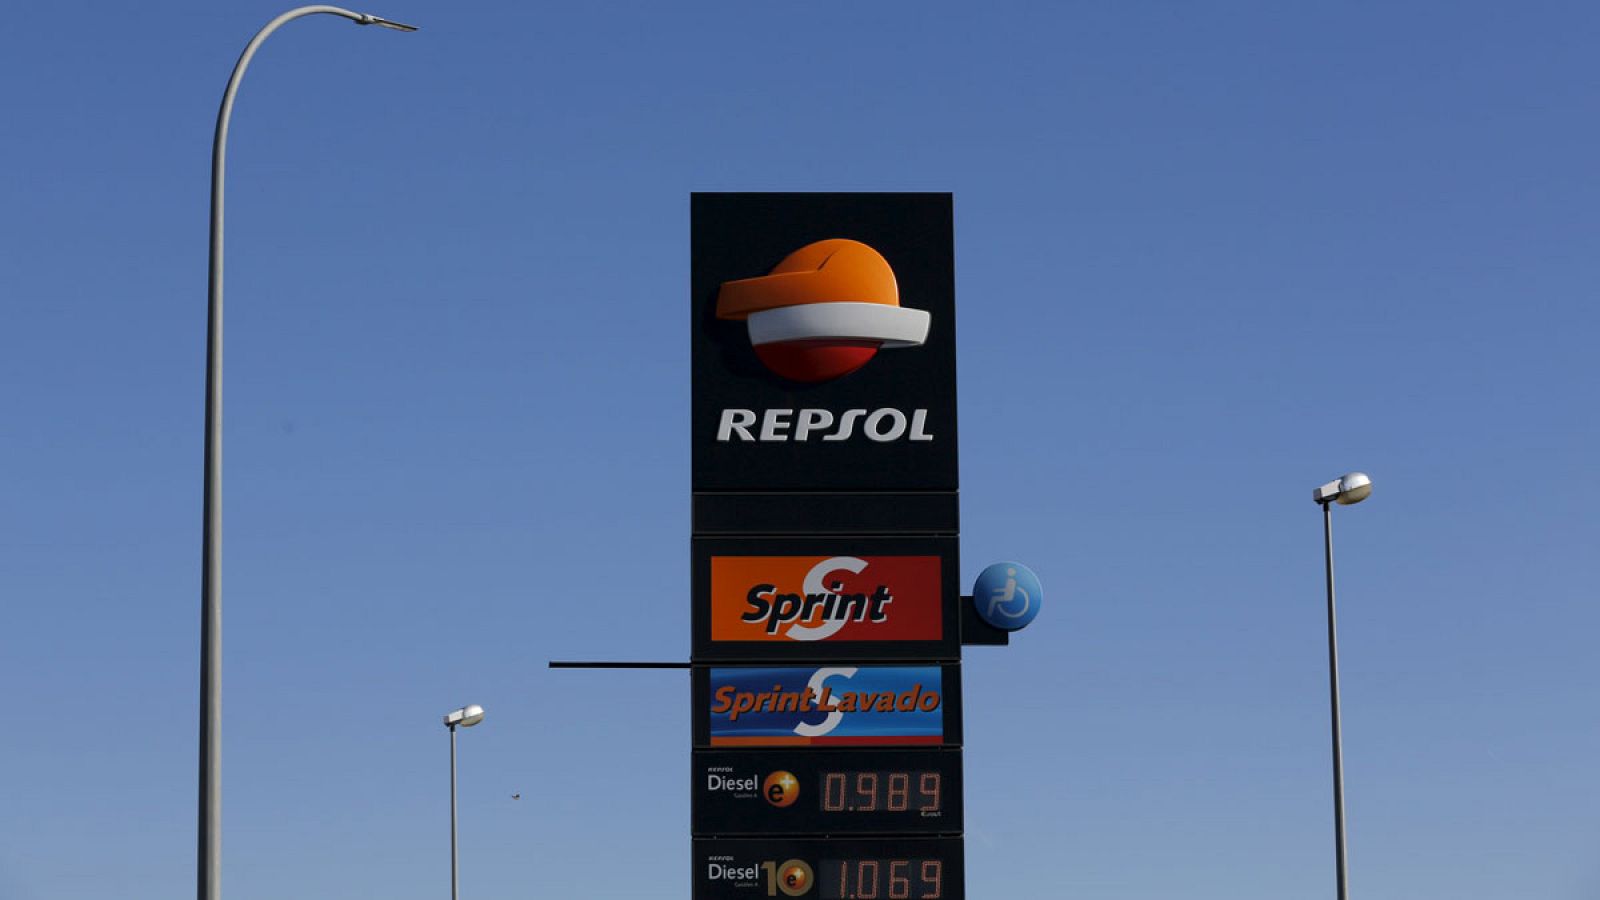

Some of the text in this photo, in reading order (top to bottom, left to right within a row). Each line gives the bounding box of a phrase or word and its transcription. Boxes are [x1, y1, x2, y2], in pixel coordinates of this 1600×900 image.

[716, 407, 934, 442] REPSOL
[741, 581, 893, 635] Sprint
[711, 683, 941, 721] Sprint Lavado
[707, 774, 758, 791] Diesel
[824, 773, 941, 812] 0.989
[708, 863, 759, 880] Diesel
[840, 860, 942, 899] 1.069
